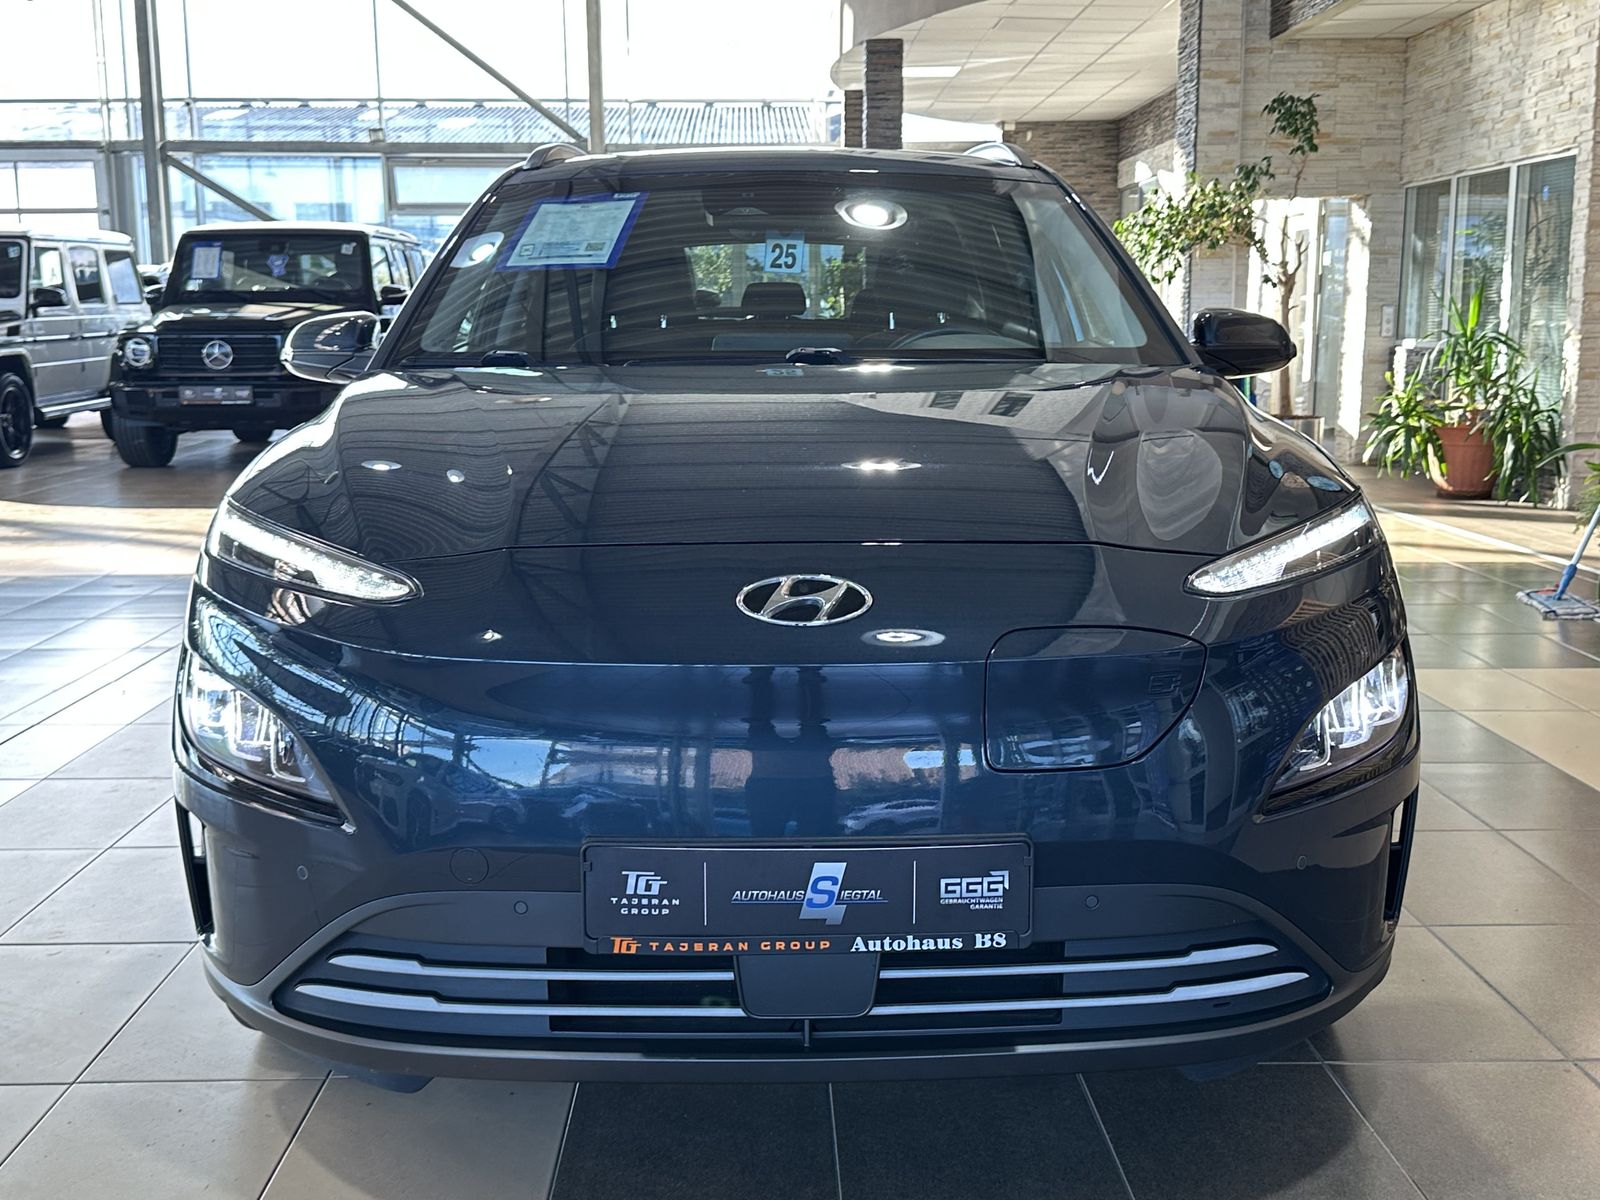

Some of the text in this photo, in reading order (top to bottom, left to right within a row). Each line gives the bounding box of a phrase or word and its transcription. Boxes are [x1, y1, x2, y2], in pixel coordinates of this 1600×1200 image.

[770, 243, 797, 269] 25
[940, 875, 1004, 898] GGG
[610, 897, 680, 905] TAJERAN
[732, 890, 805, 901] AUTOHAUS
[940, 897, 1004, 905] GEBRAUCHTWAGEN
[620, 907, 670, 915] GROUP
[649, 942, 748, 952] TAJERAN
[760, 941, 831, 950] GROUP
[850, 935, 964, 952] Autohaus
